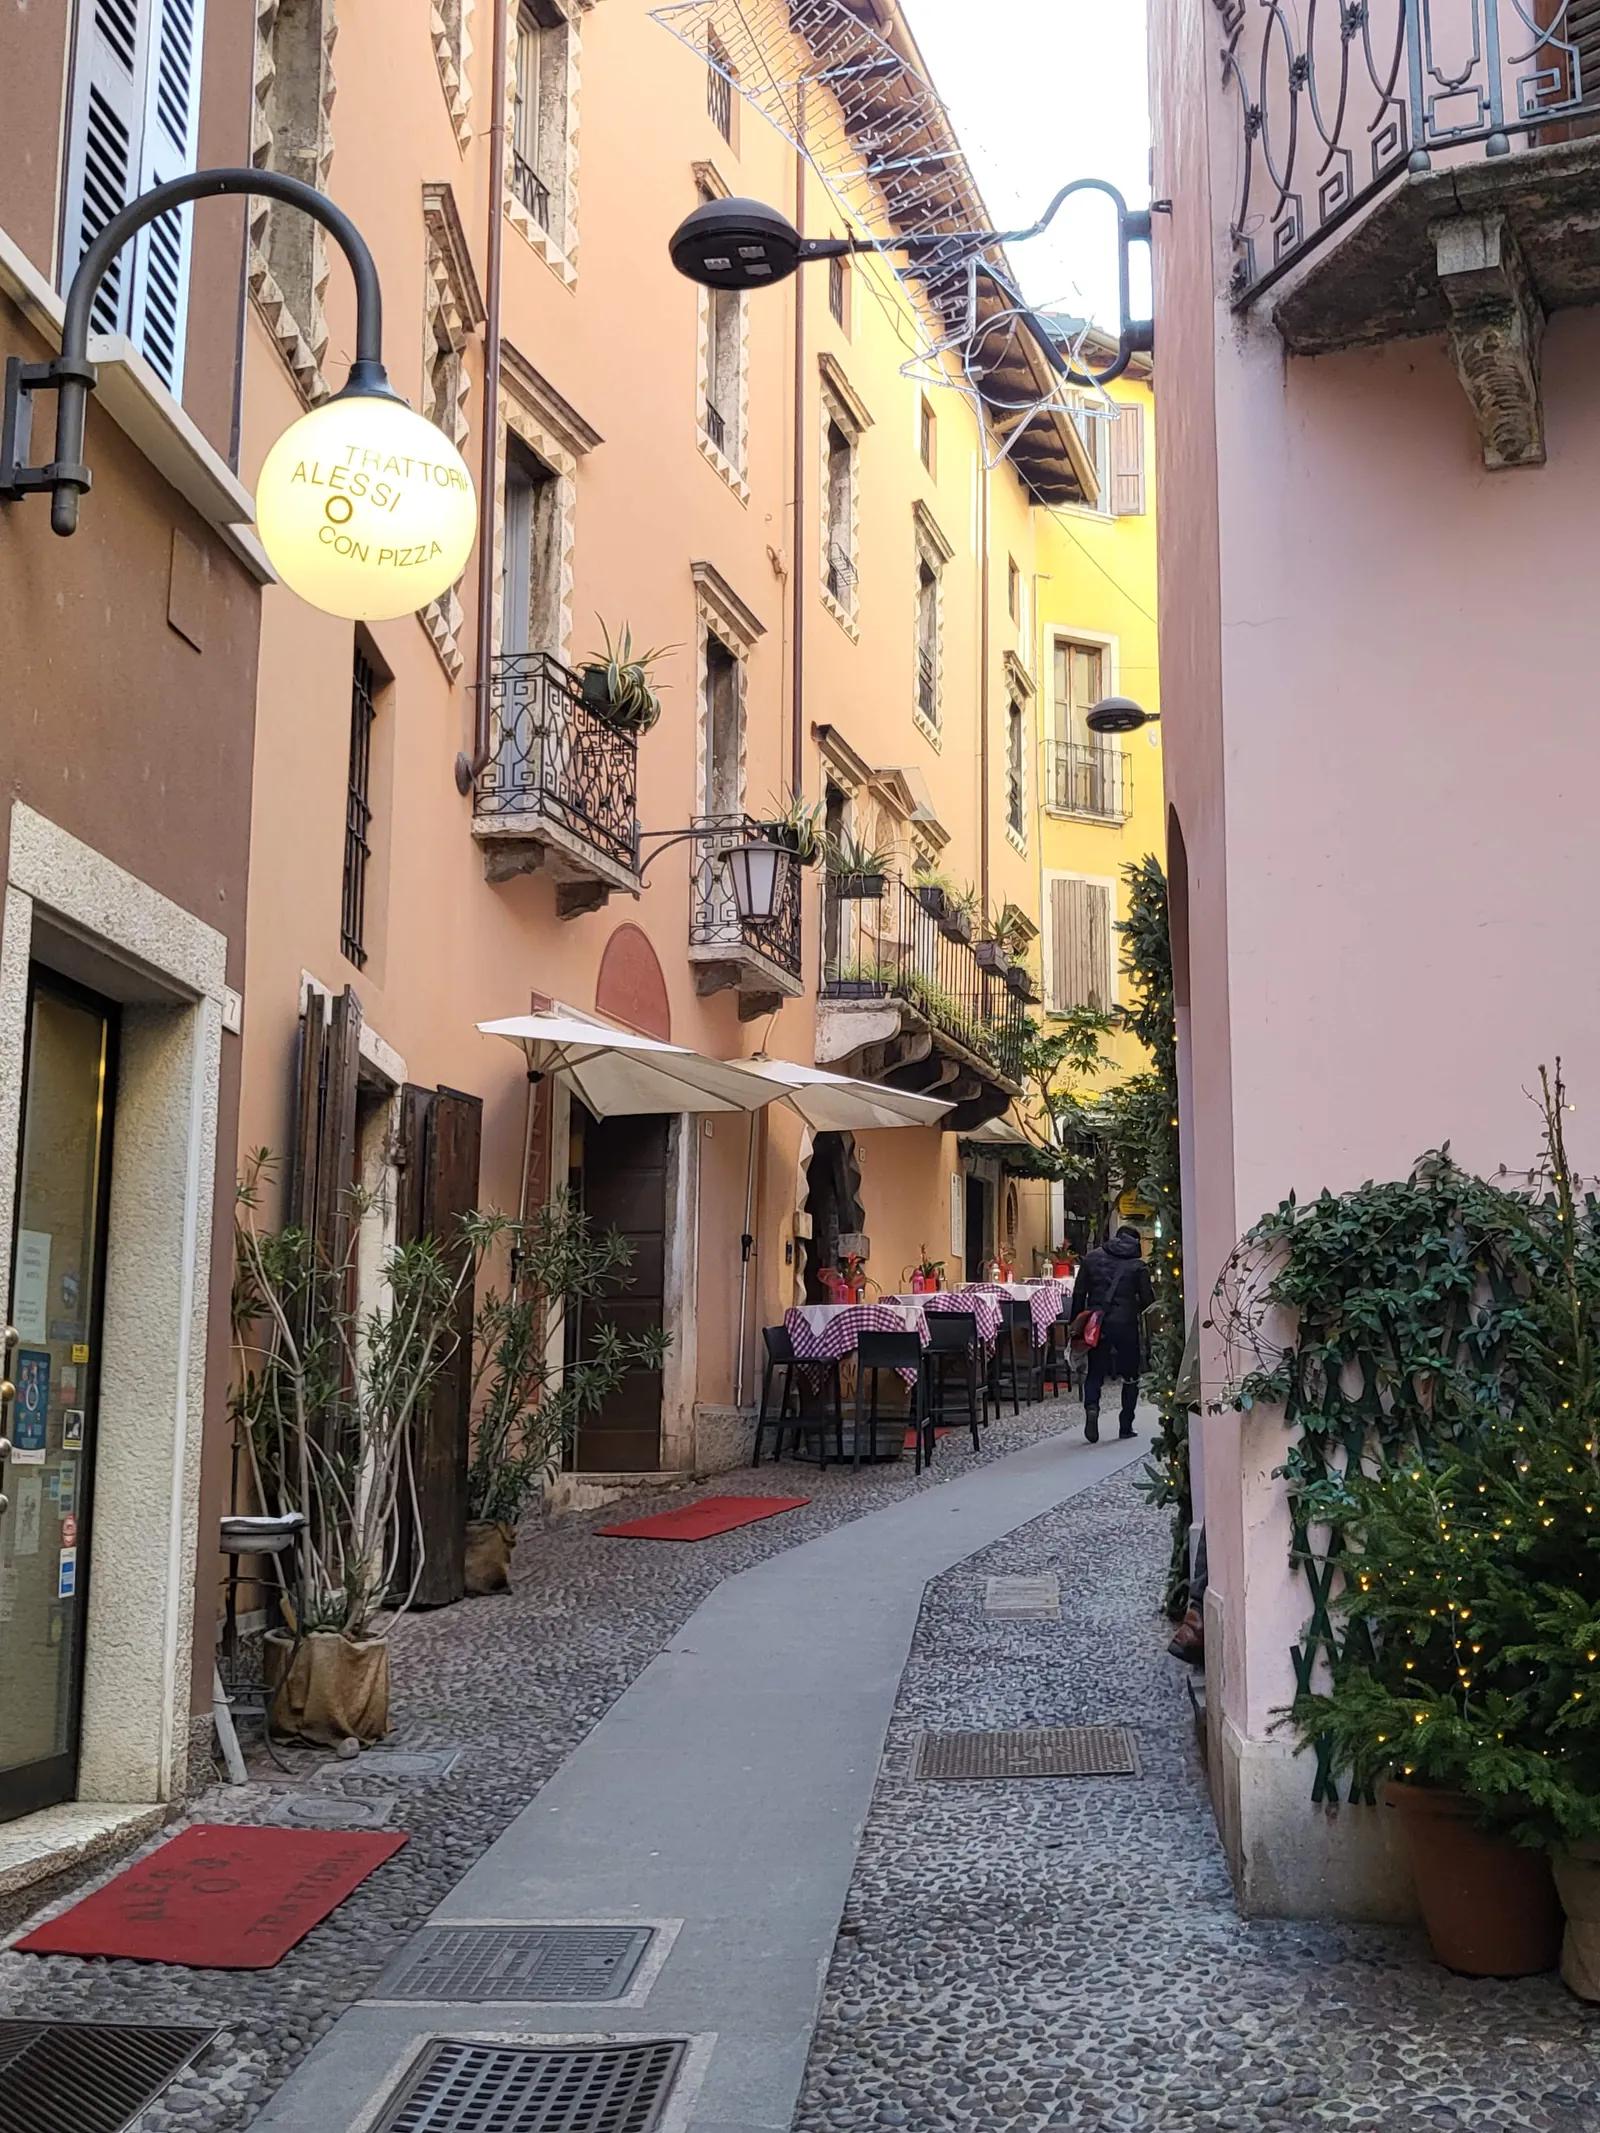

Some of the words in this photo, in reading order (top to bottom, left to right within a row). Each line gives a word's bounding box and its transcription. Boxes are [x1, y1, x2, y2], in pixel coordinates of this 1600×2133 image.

[291, 461, 401, 512] ALESSI
[318, 526, 369, 562] CON
[377, 541, 442, 567] PIZZA
[230, 998, 236, 1020] 7
